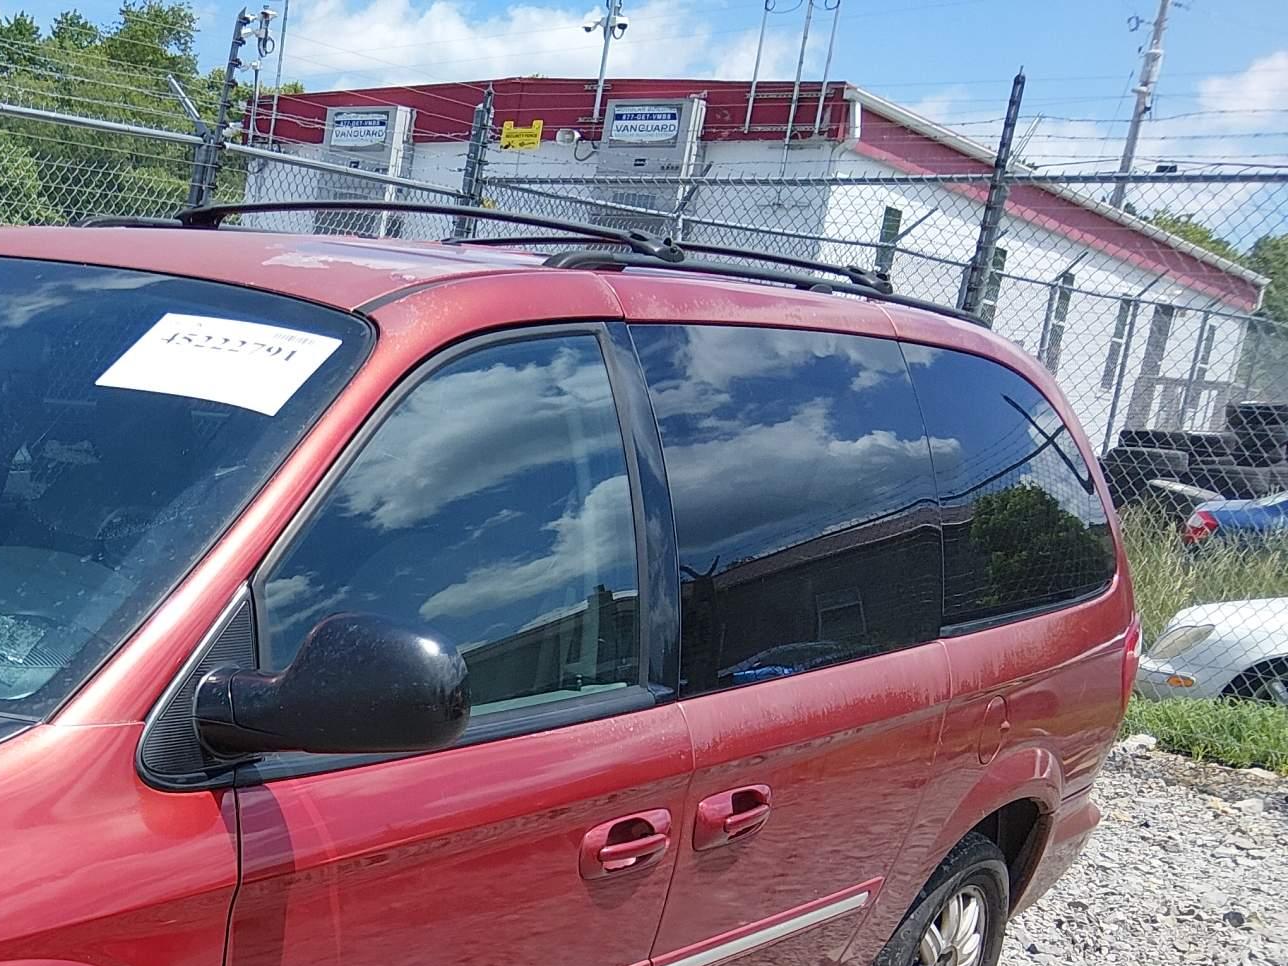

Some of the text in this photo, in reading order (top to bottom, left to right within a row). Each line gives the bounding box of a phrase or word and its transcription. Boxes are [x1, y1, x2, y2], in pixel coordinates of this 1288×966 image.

[615, 123, 677, 133] VANGUARD
[334, 129, 385, 138] VANGUARD
[160, 331, 298, 362] 45222791
